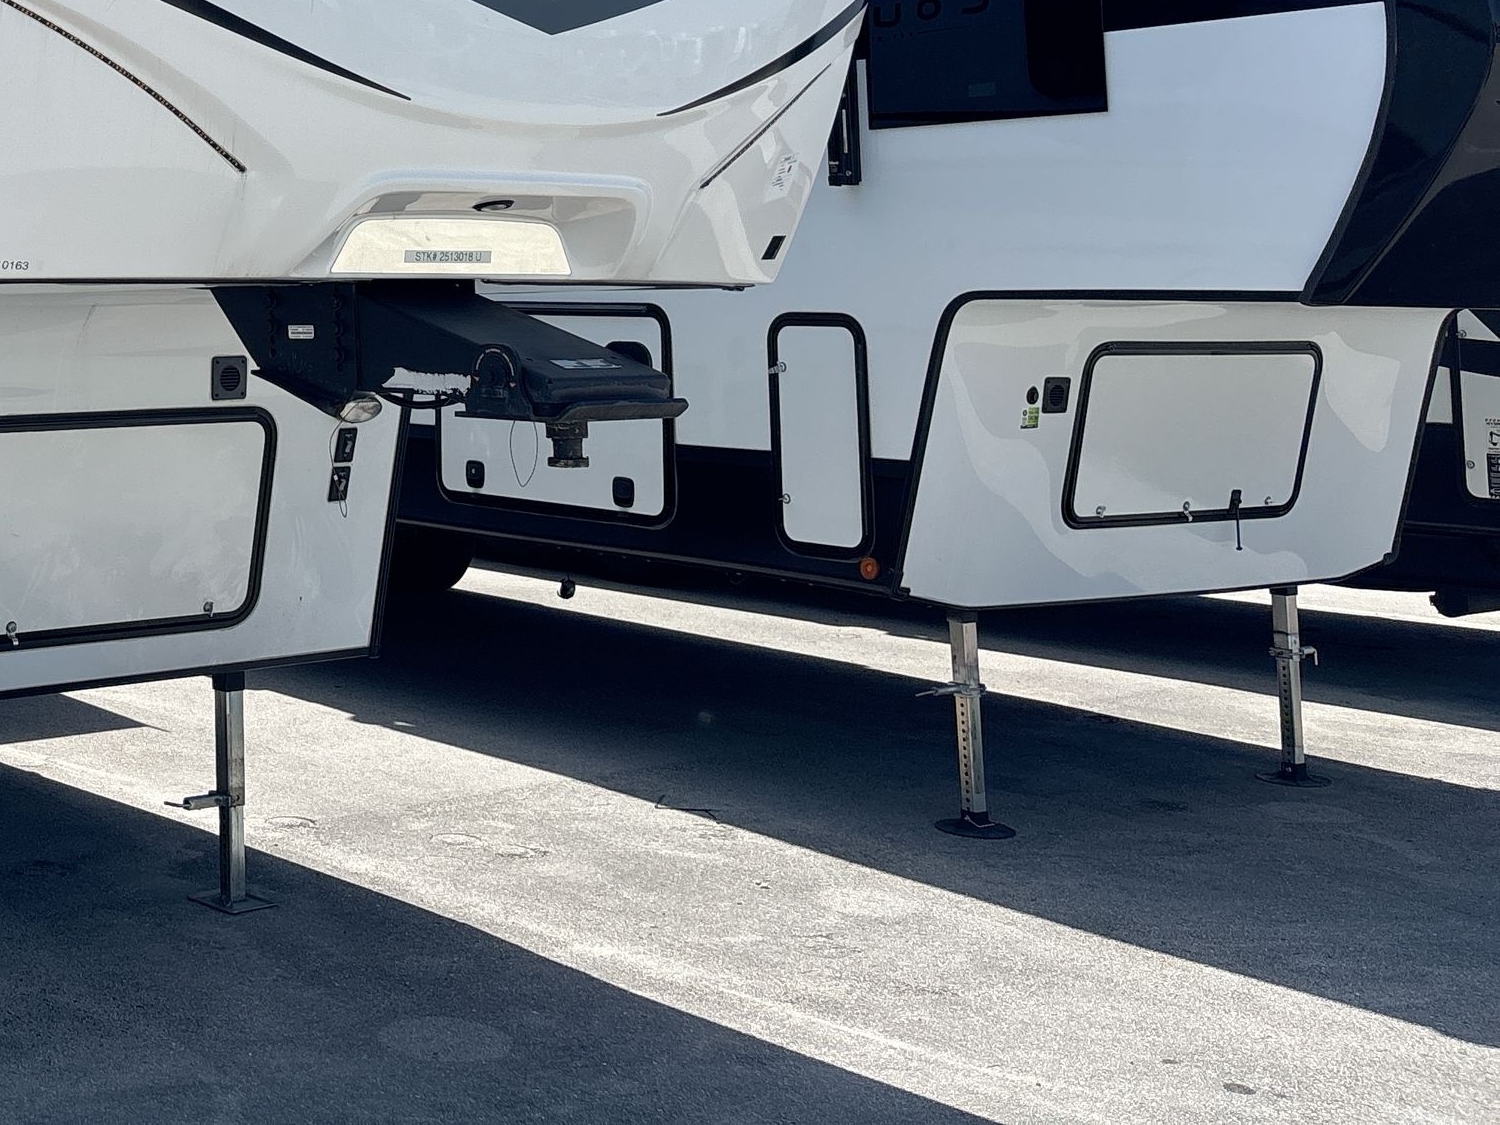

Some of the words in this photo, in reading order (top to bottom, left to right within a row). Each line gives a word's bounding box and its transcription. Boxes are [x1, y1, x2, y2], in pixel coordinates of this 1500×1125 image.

[415, 251, 437, 262] STK#
[440, 251, 474, 262] 2513018
[475, 252, 483, 262] U
